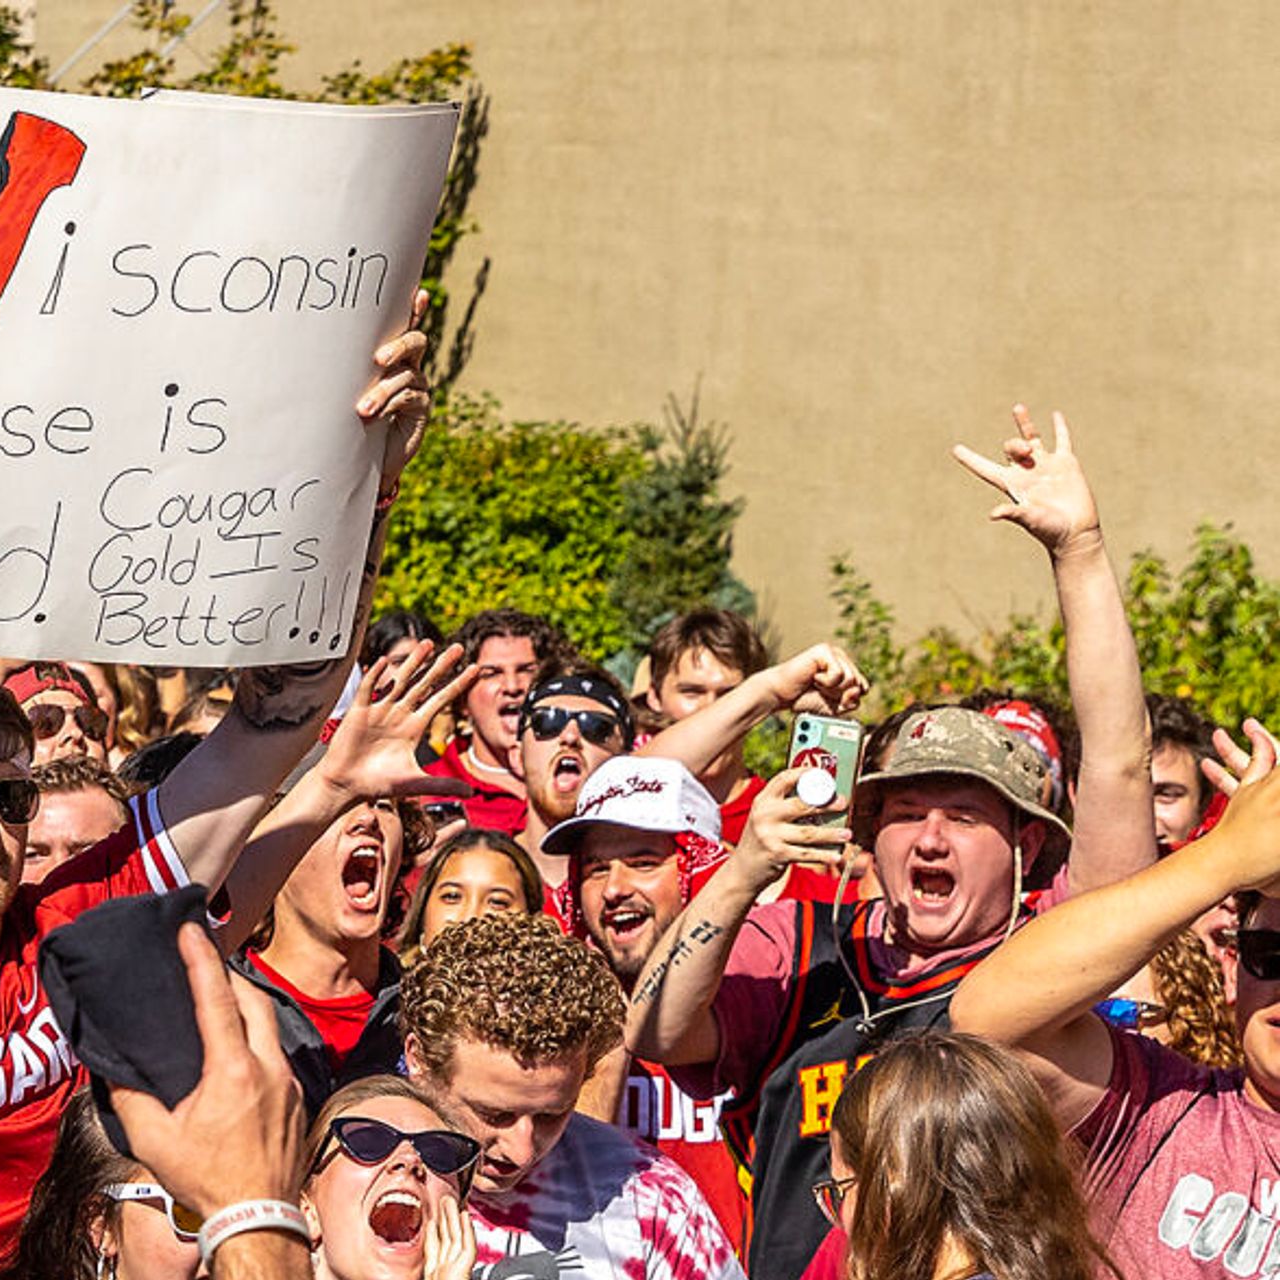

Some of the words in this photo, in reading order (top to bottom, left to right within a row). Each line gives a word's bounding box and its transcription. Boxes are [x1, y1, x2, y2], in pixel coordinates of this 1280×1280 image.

[160, 382, 228, 454] is
[99, 467, 322, 540] Cougar
[87, 533, 204, 595] Gold
[208, 531, 322, 580] Is
[94, 572, 352, 651] Better!!!
